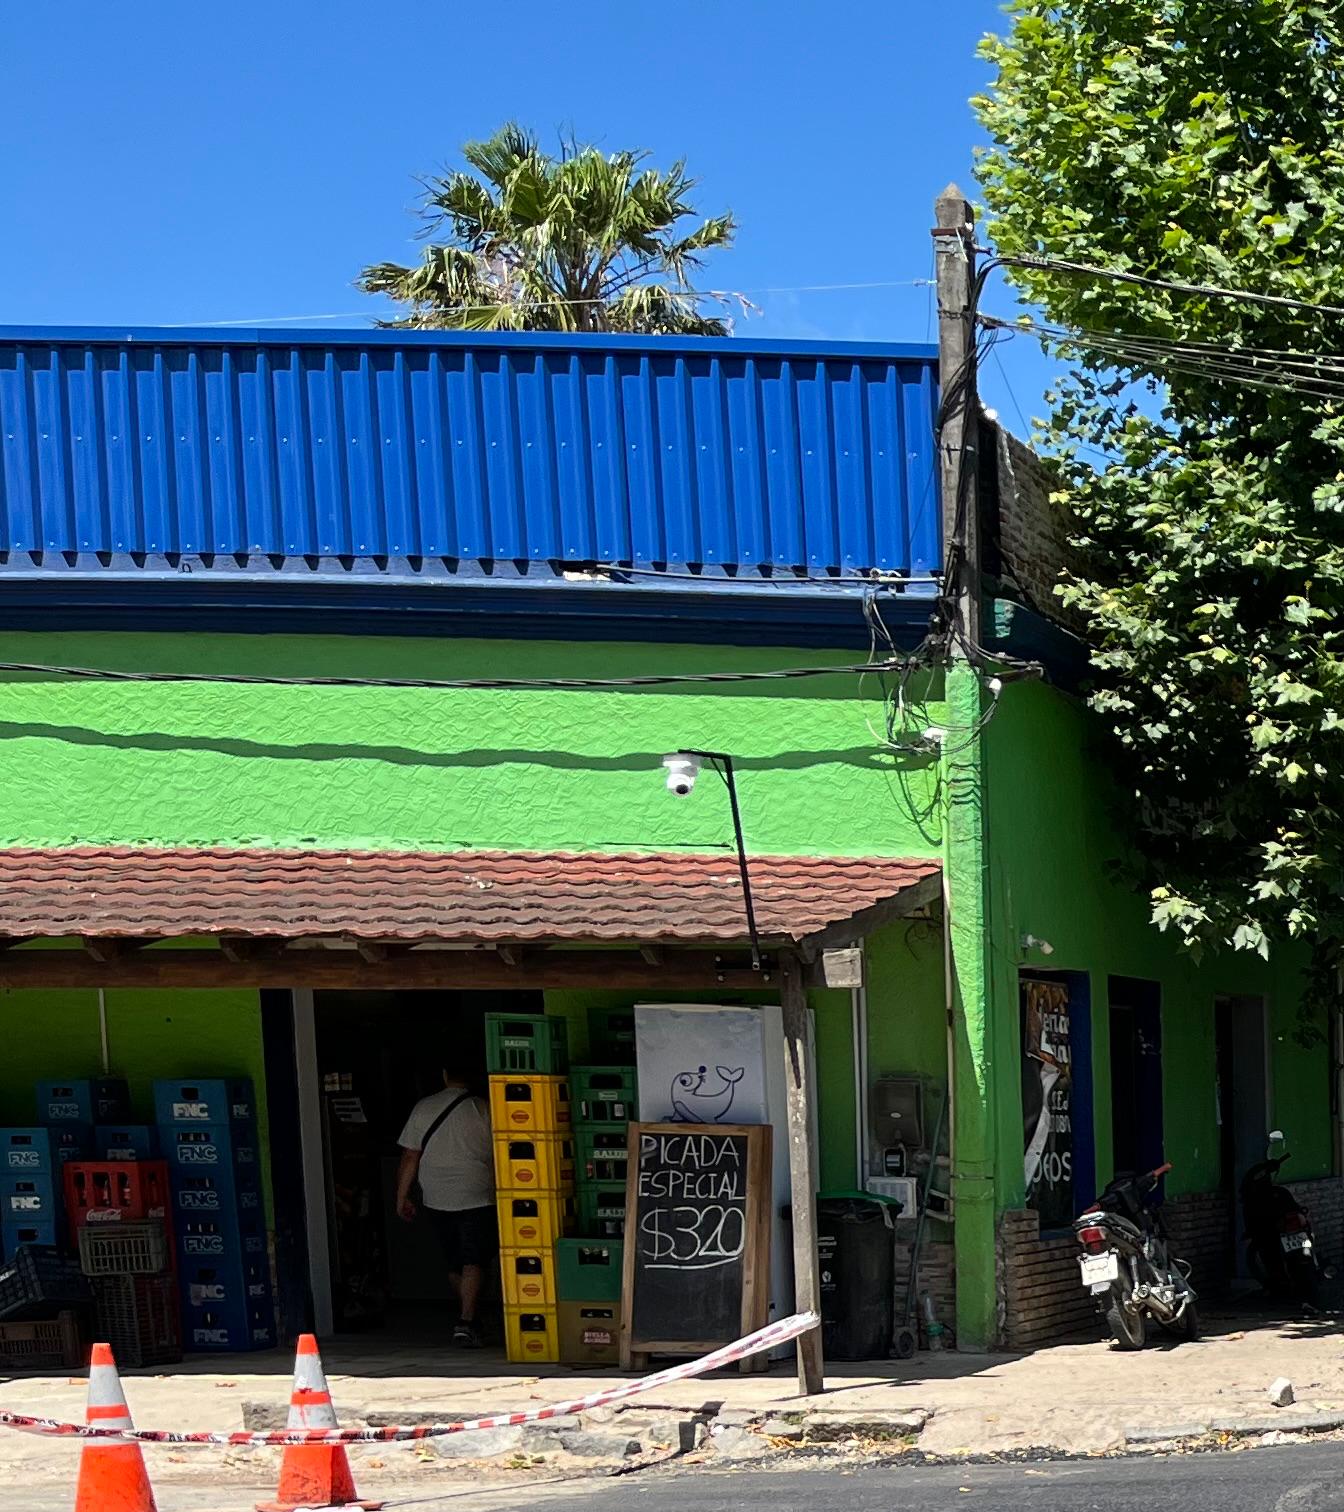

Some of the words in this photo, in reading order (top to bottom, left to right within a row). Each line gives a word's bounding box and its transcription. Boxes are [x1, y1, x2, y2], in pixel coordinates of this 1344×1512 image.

[171, 1103, 210, 1120] FNC
[8, 1151, 40, 1167] FNC
[177, 1145, 218, 1164] FNC
[640, 1134, 740, 1170] PICADA
[638, 1169, 746, 1200] ESPECIAL
[10, 1196, 41, 1211] FNC
[178, 1190, 220, 1210] FNC
[640, 1204, 745, 1261] $320
[183, 1234, 224, 1255] FNC
